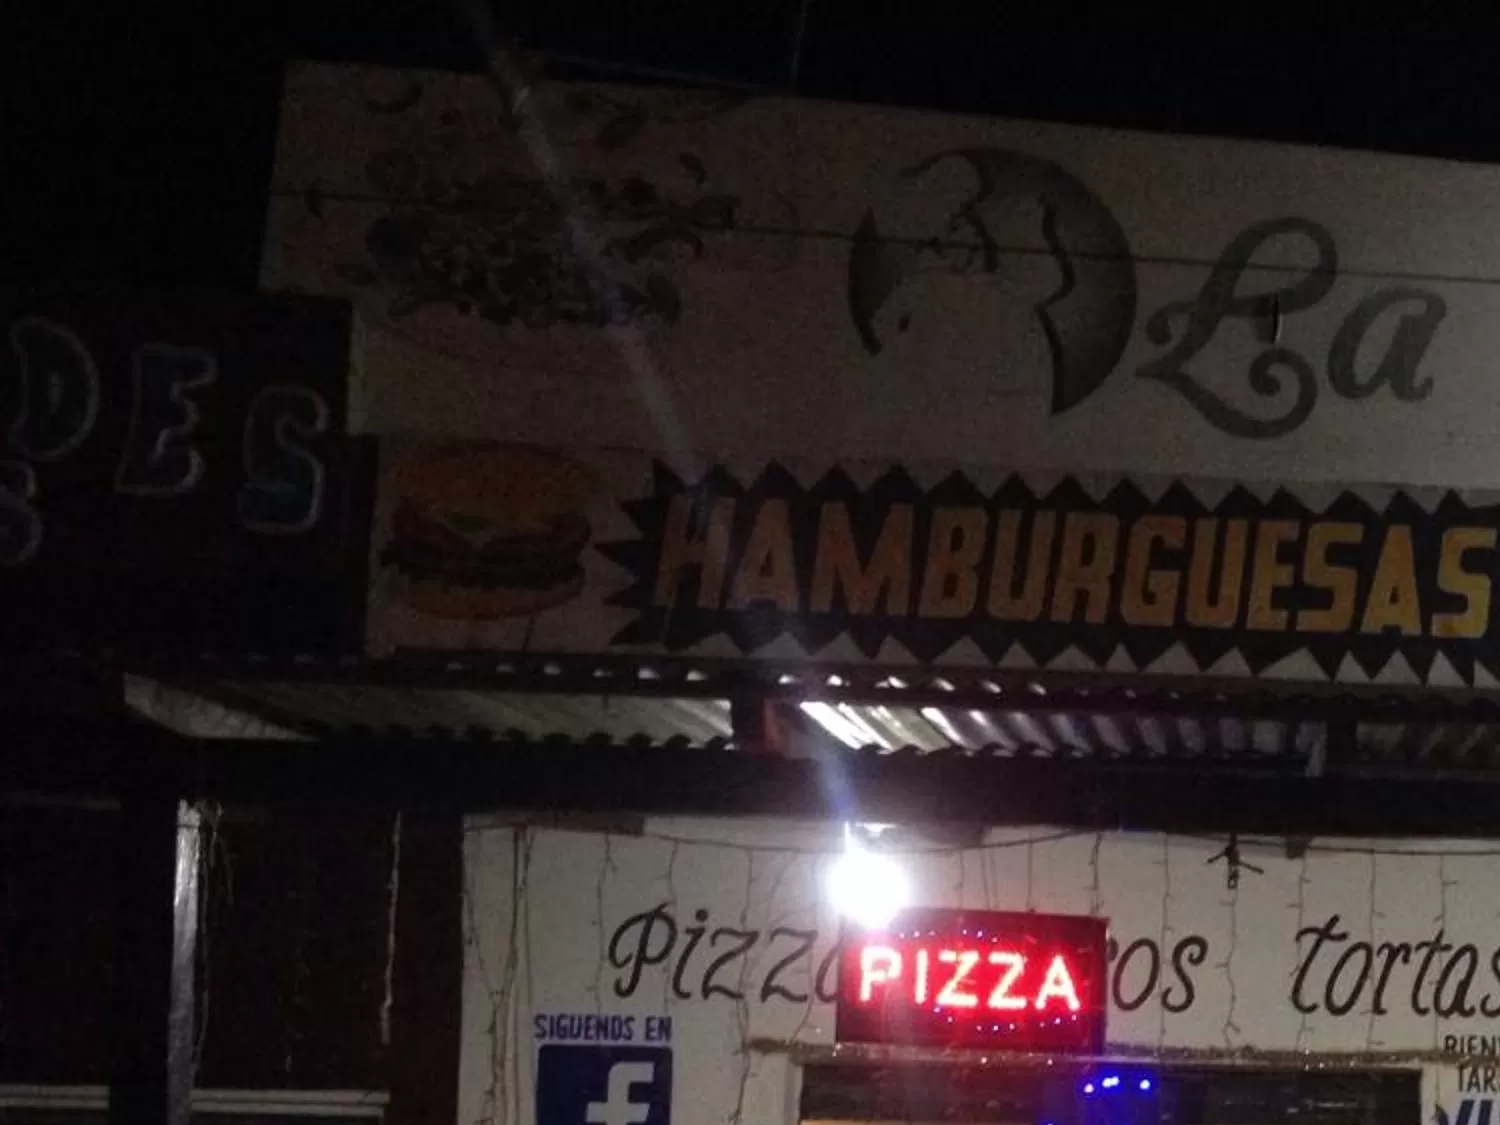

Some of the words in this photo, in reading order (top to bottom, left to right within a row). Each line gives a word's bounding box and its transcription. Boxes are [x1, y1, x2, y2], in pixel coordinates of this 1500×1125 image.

[1136, 216, 1447, 439] La
[653, 496, 1498, 640] HAMBURGUESAS
[534, 1014, 635, 1041] SIGUENOS
[645, 1016, 672, 1041] EN
[857, 945, 1081, 1010] PIZZA
